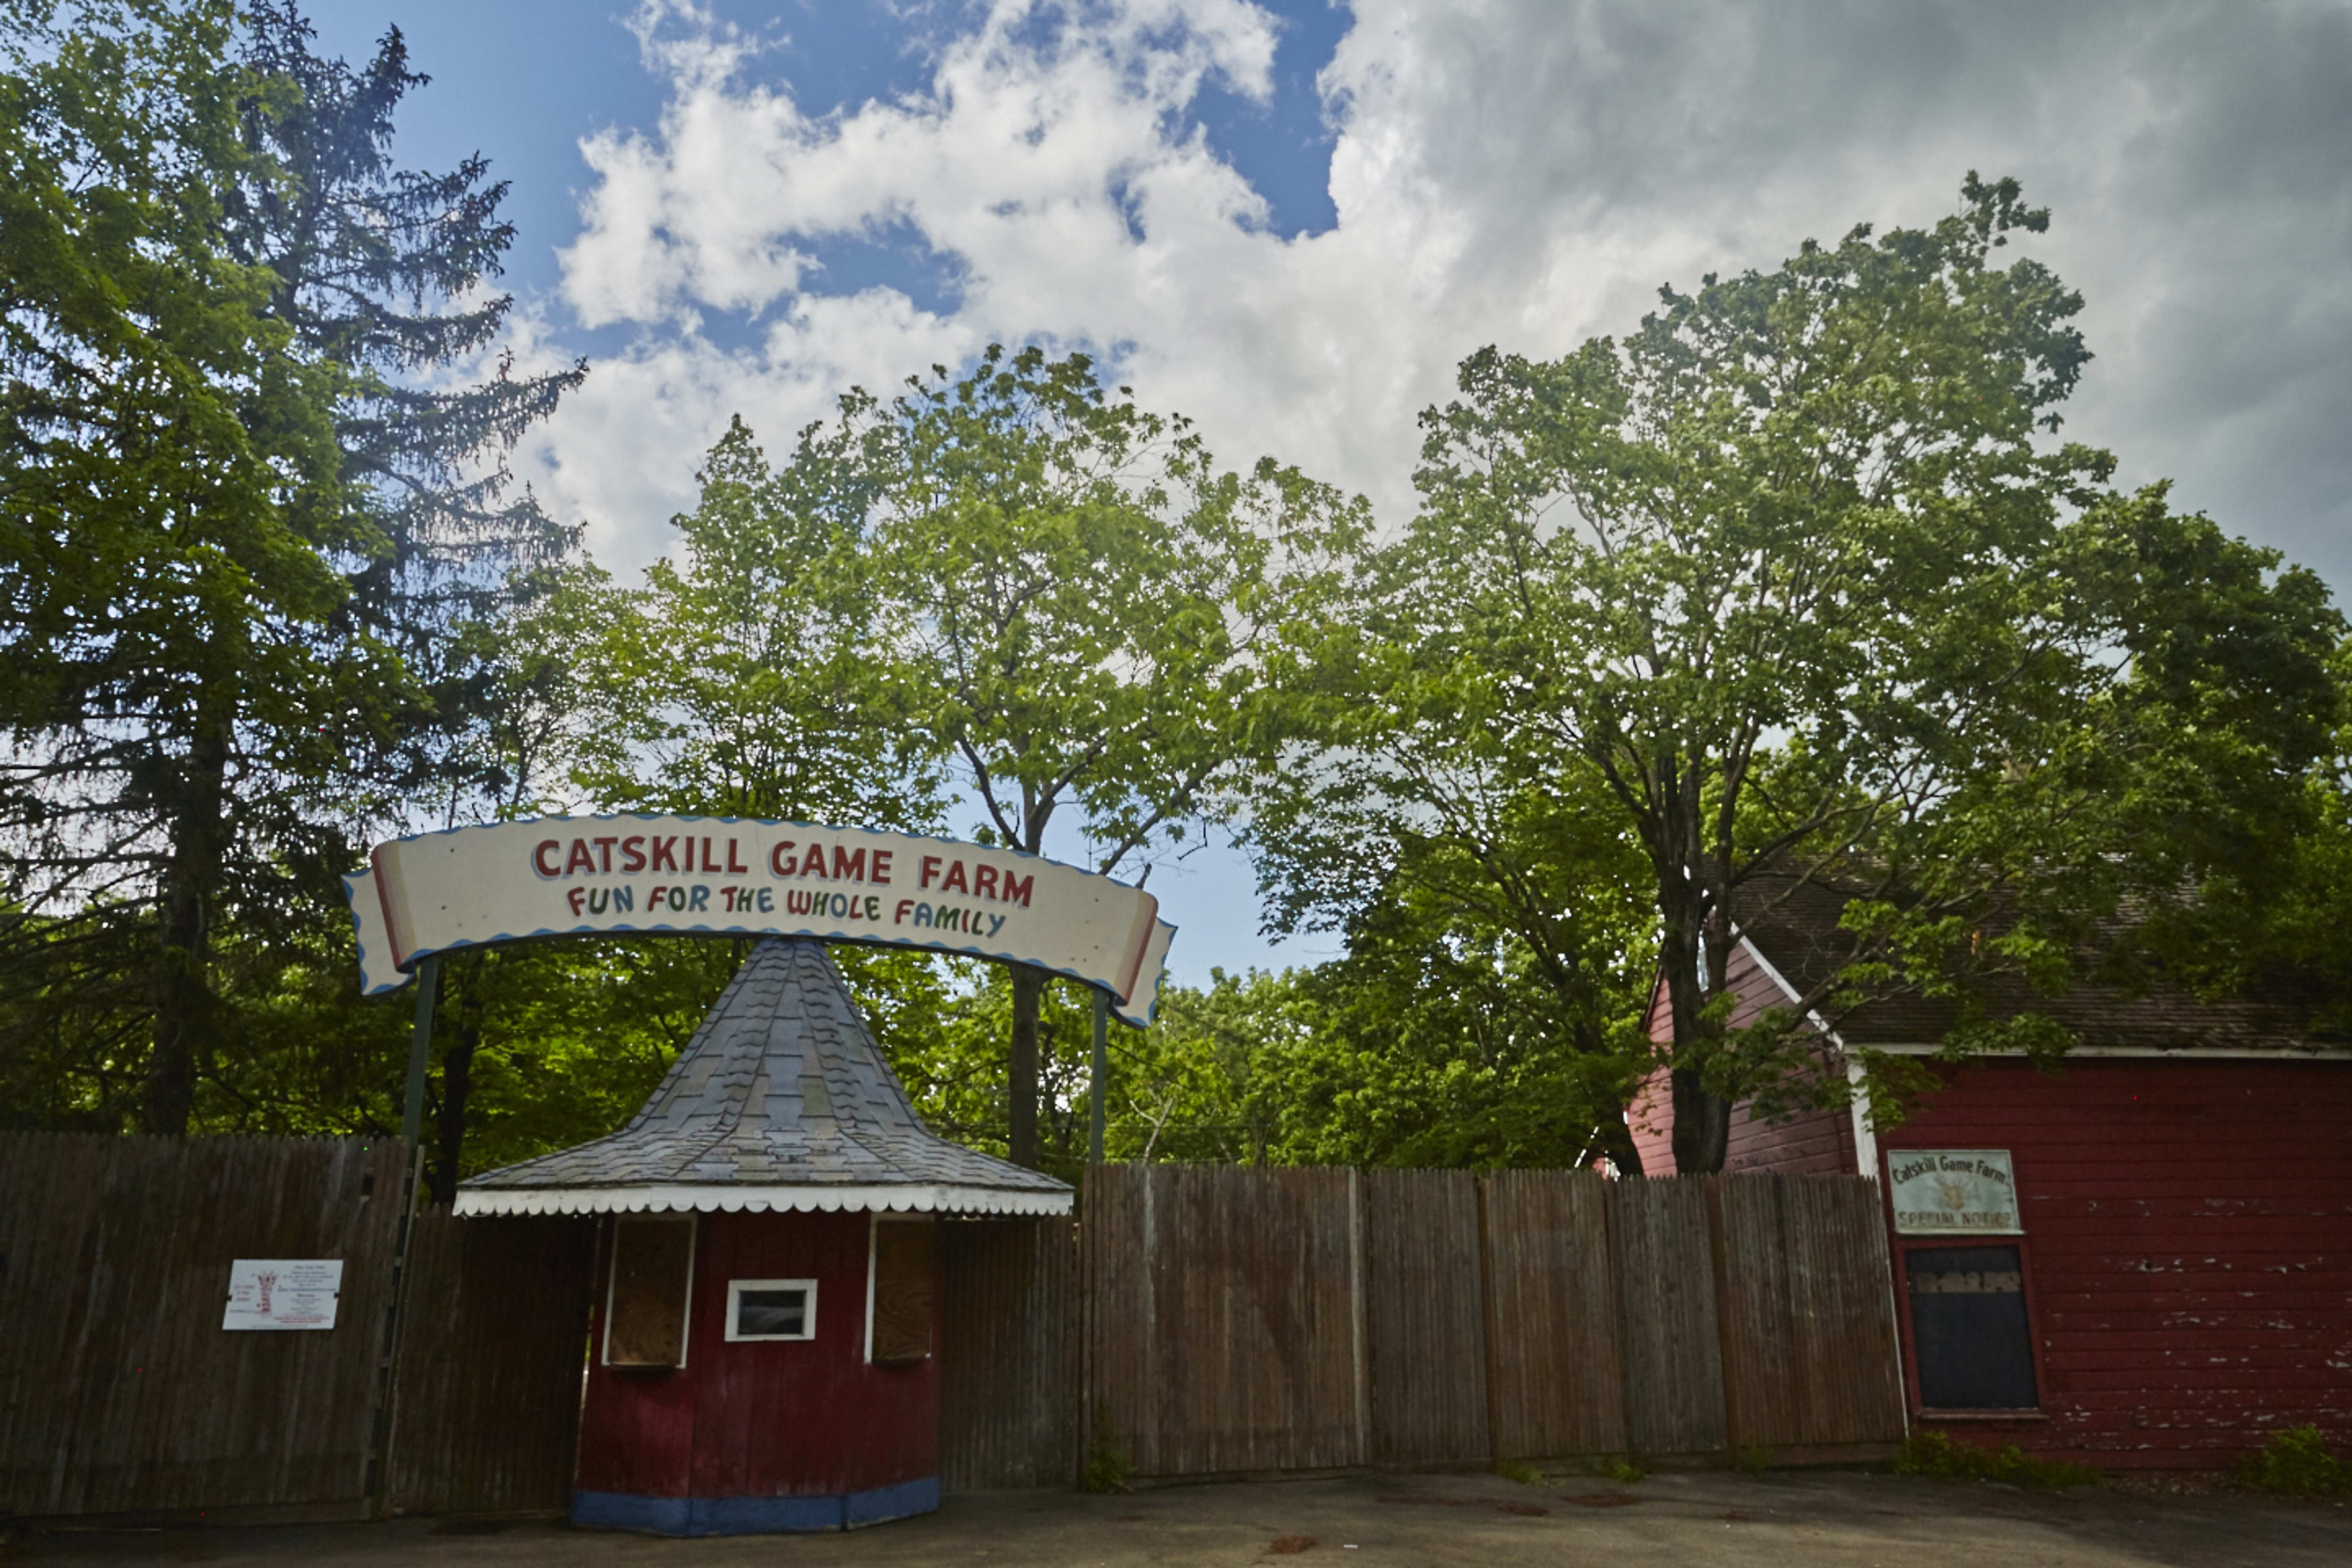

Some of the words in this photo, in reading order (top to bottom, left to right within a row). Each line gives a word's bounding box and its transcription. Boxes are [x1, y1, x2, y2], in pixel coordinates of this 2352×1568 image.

[532, 835, 748, 878] CATSKILL
[771, 840, 893, 885] GAME
[919, 855, 1035, 908] FARM
[567, 885, 634, 917] FUN
[647, 885, 710, 913] FOR
[720, 886, 775, 913] THE
[786, 889, 881, 921] WHOLE
[894, 899, 1006, 938] FAMILY
[1892, 1156, 1937, 1184] Catskill
[1939, 1155, 1973, 1174] Game
